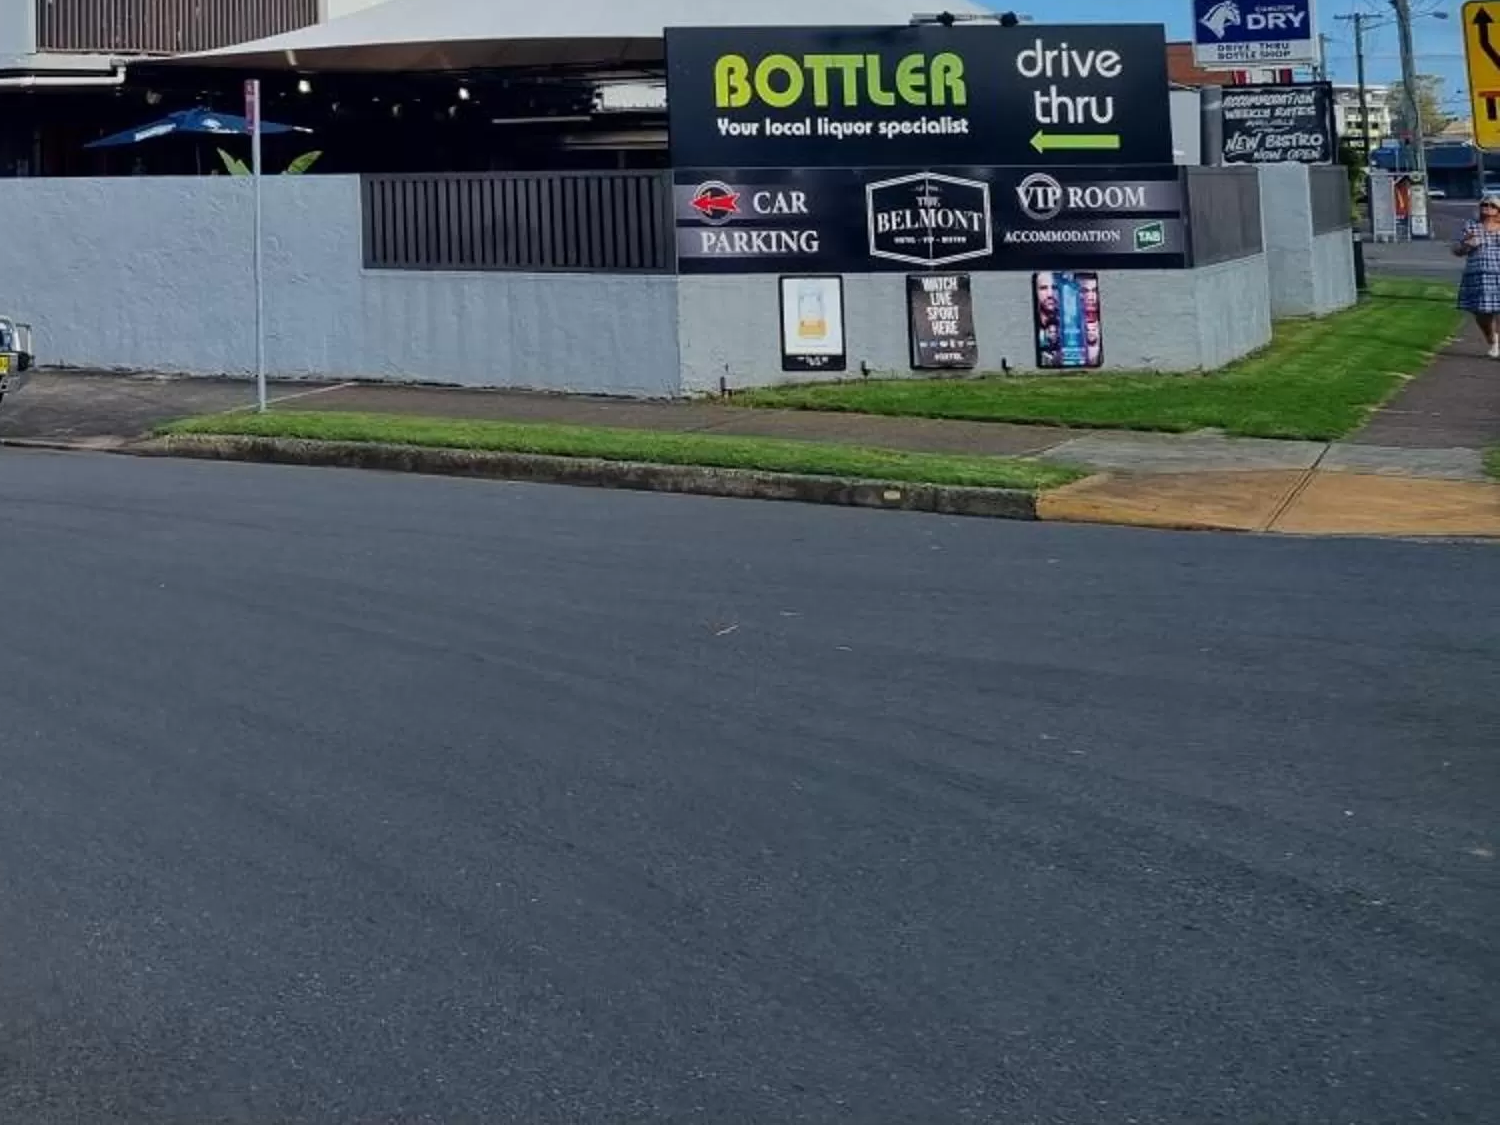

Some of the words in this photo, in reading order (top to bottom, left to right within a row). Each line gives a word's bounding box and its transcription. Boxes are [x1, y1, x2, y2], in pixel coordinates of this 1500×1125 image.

[1246, 11, 1305, 30] DRY
[1016, 38, 1122, 78] drive
[715, 53, 967, 107] BOTTLER
[1033, 84, 1113, 124] thru
[717, 118, 760, 136] Your
[765, 117, 811, 136] local
[817, 117, 873, 140] liquor
[879, 116, 969, 139] specialist
[1225, 131, 1263, 153] NEW
[1265, 132, 1323, 148] BISTRO
[752, 190, 809, 214] CAR
[1015, 186, 1062, 208] VIP
[1067, 186, 1146, 208] ROOM
[877, 208, 983, 233] BELMONT
[700, 229, 820, 253] PARKING
[1003, 229, 1121, 243] ACCOMMODATION
[1137, 230, 1161, 242] TAB
[921, 276, 958, 292] WATCH
[930, 291, 953, 306] LIVE
[926, 306, 959, 321] SPORT
[931, 320, 960, 336] HERE
